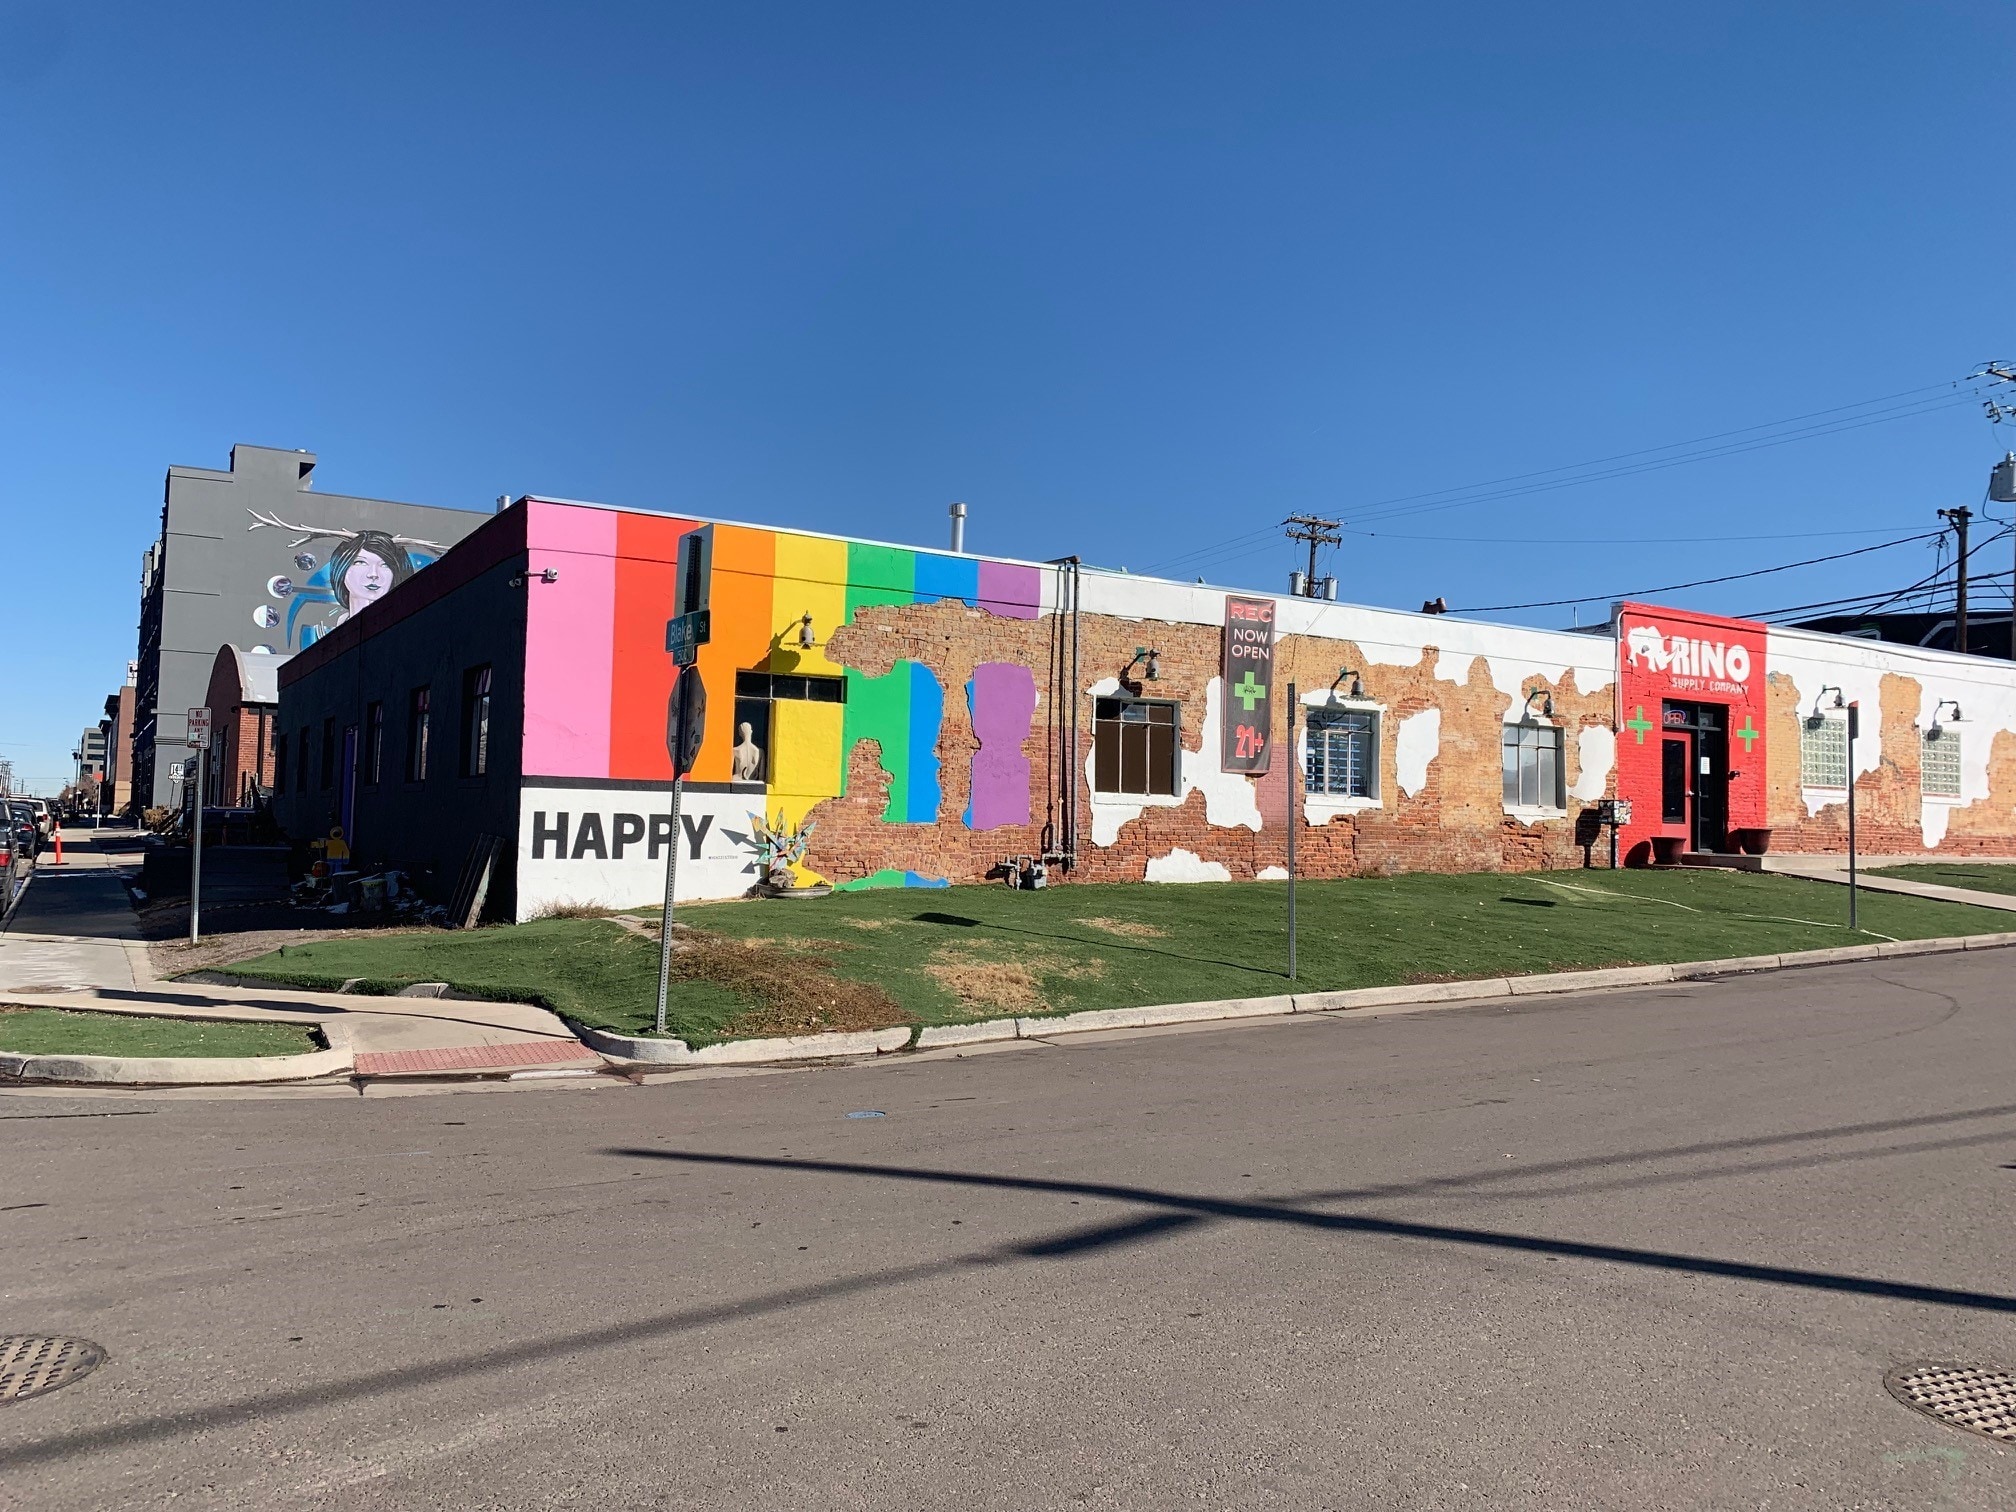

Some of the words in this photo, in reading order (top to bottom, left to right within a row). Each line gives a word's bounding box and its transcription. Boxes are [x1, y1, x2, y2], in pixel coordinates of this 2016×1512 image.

[1230, 603, 1272, 623] REC
[670, 621, 692, 644] Blake
[699, 621, 706, 633] St
[1234, 628, 1268, 644] NOW
[1231, 644, 1270, 660] OPEN
[1672, 636, 1750, 682] RINO
[1672, 677, 1706, 691] SUPPLY
[1709, 681, 1749, 695] COMPANY
[189, 719, 209, 727] PARKING
[195, 710, 203, 718] NO
[1235, 724, 1264, 759] 21+
[532, 811, 714, 860] HAPPY
